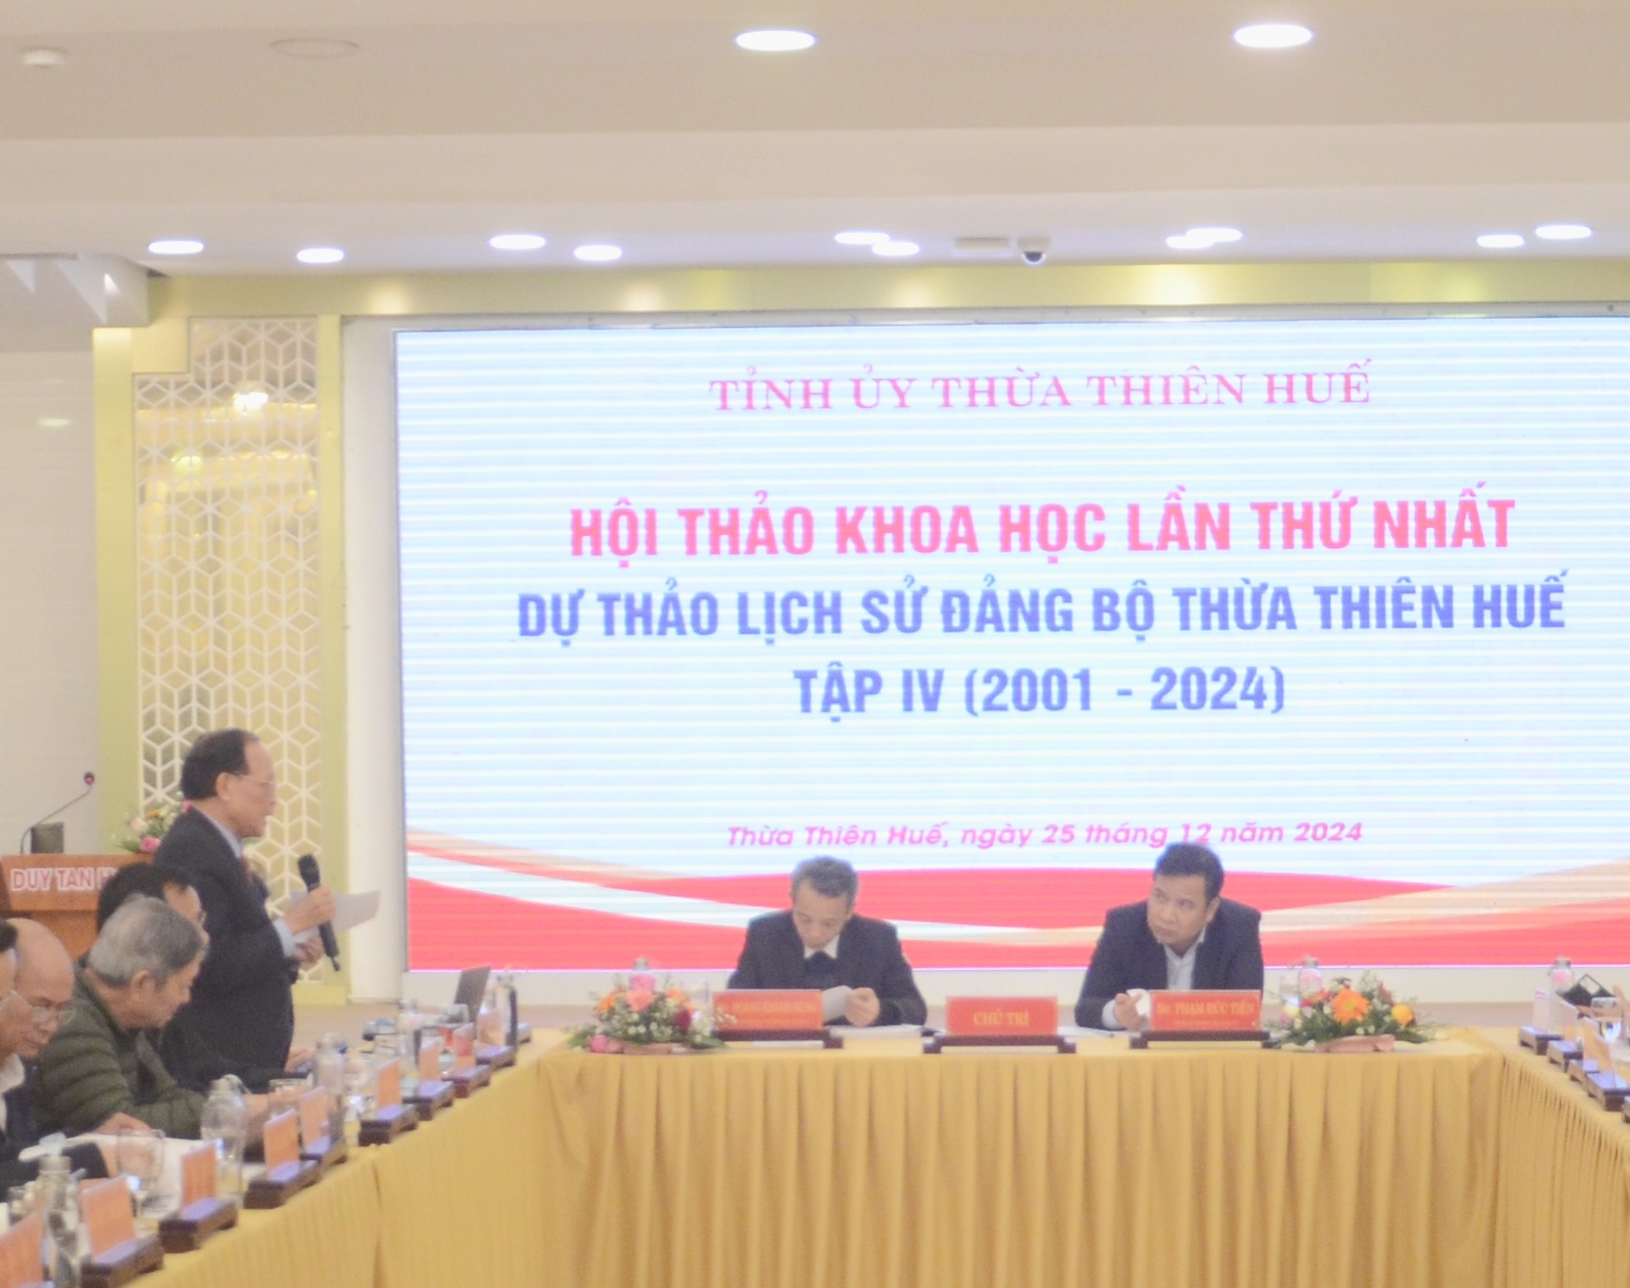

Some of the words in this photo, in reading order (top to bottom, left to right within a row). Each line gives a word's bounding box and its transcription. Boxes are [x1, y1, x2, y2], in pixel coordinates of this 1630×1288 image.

[709, 366, 833, 412] TỈNH
[849, 364, 916, 410] ỦY
[931, 367, 1072, 409] THỪA
[1086, 365, 1246, 407] THIÊN
[1264, 357, 1372, 405] HUẾ
[570, 497, 658, 570] HỘI
[677, 490, 815, 557] THẢO
[835, 505, 979, 555] KHOA
[999, 503, 1106, 565] HỌC
[1127, 485, 1231, 552] LẦN
[1250, 490, 1359, 551] THỨ
[1373, 481, 1516, 550] NHẤT
[518, 588, 585, 647] DỰ
[597, 578, 719, 637] THẢO
[737, 591, 843, 645] LỊCH
[861, 575, 929, 635] SỬ
[940, 574, 1073, 633] ĐẢNG
[1092, 579, 1155, 642] BỘ
[1172, 578, 1297, 631] THỪA
[1313, 576, 1454, 630] THIÊN
[1473, 570, 1567, 629] HUẾ
[793, 661, 883, 723] TẬP
[902, 669, 944, 713] IV
[964, 668, 1091, 717] (2001
[1116, 689, 1133, 697] -
[1151, 666, 1285, 714] 2024)
[727, 825, 794, 847] Thừa
[805, 824, 877, 847] Thiên
[886, 821, 949, 848] Huế,
[960, 823, 1033, 850] ngày
[1041, 824, 1076, 845] 25
[1085, 822, 1168, 848] tháng
[1181, 823, 1212, 845] 12
[1219, 822, 1284, 844] năm
[1293, 822, 1363, 843] 2024
[10, 867, 52, 891] DUY
